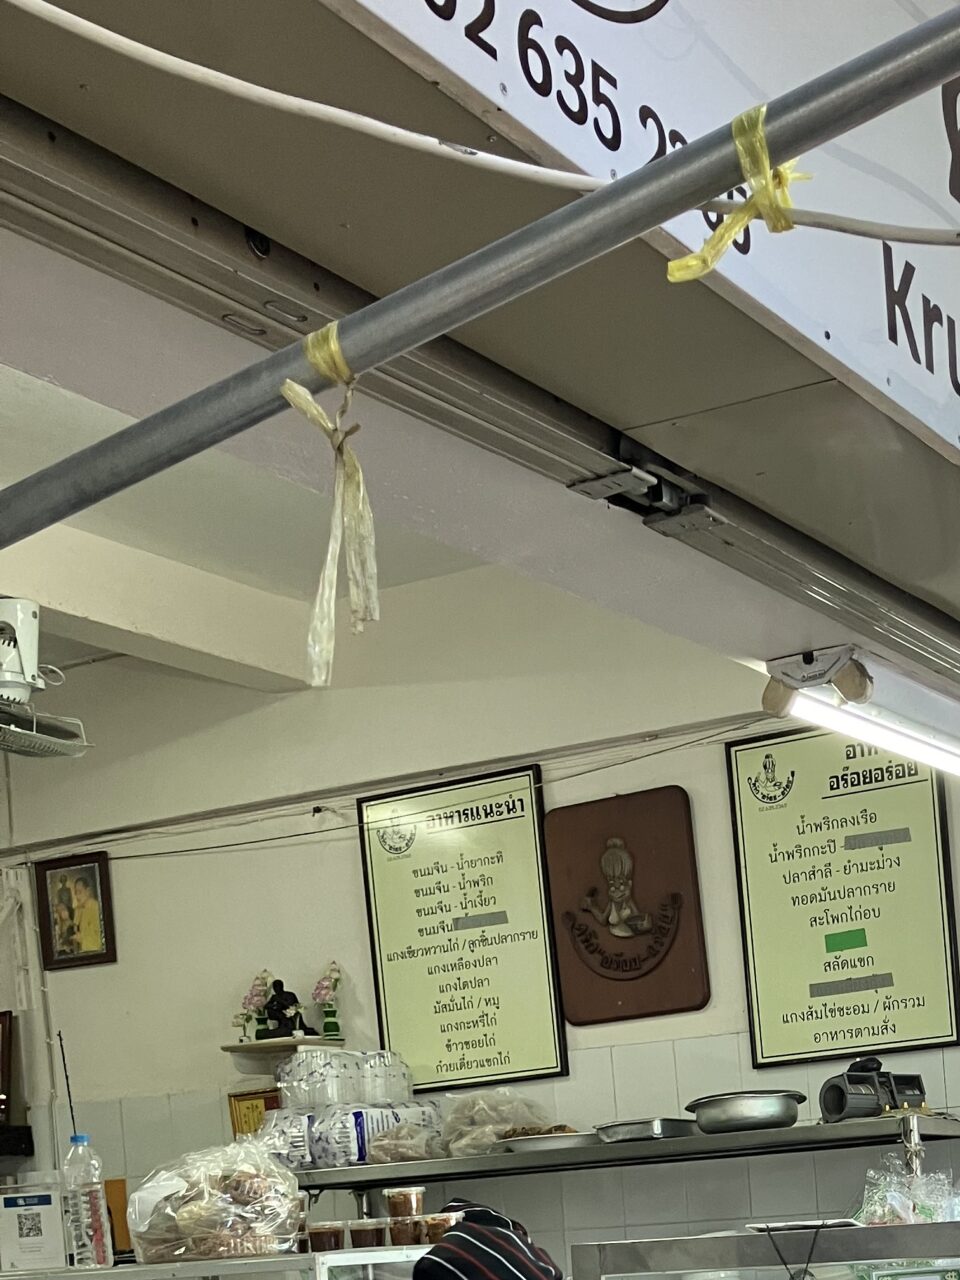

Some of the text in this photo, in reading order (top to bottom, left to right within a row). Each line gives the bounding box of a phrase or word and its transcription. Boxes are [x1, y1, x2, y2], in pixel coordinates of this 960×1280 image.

[517, 9, 622, 152] 635
[426, 795, 525, 829] อาหารแนะนำ
[796, 810, 878, 836] น้ำพริกลงเรือ
[458, 871, 494, 892] น้ำพริก
[791, 881, 896, 907] ทอดมันปลากราย
[809, 904, 881, 929] สะโพกไก่อบ
[427, 955, 498, 976] แกงเหลืองปลา
[823, 954, 875, 973] สลัดแขก
[782, 1000, 870, 1024] แกงส้มไข่ชะอม
[883, 995, 926, 1013] ผักรวม
[813, 1016, 897, 1044] อาหารตามสั่ง
